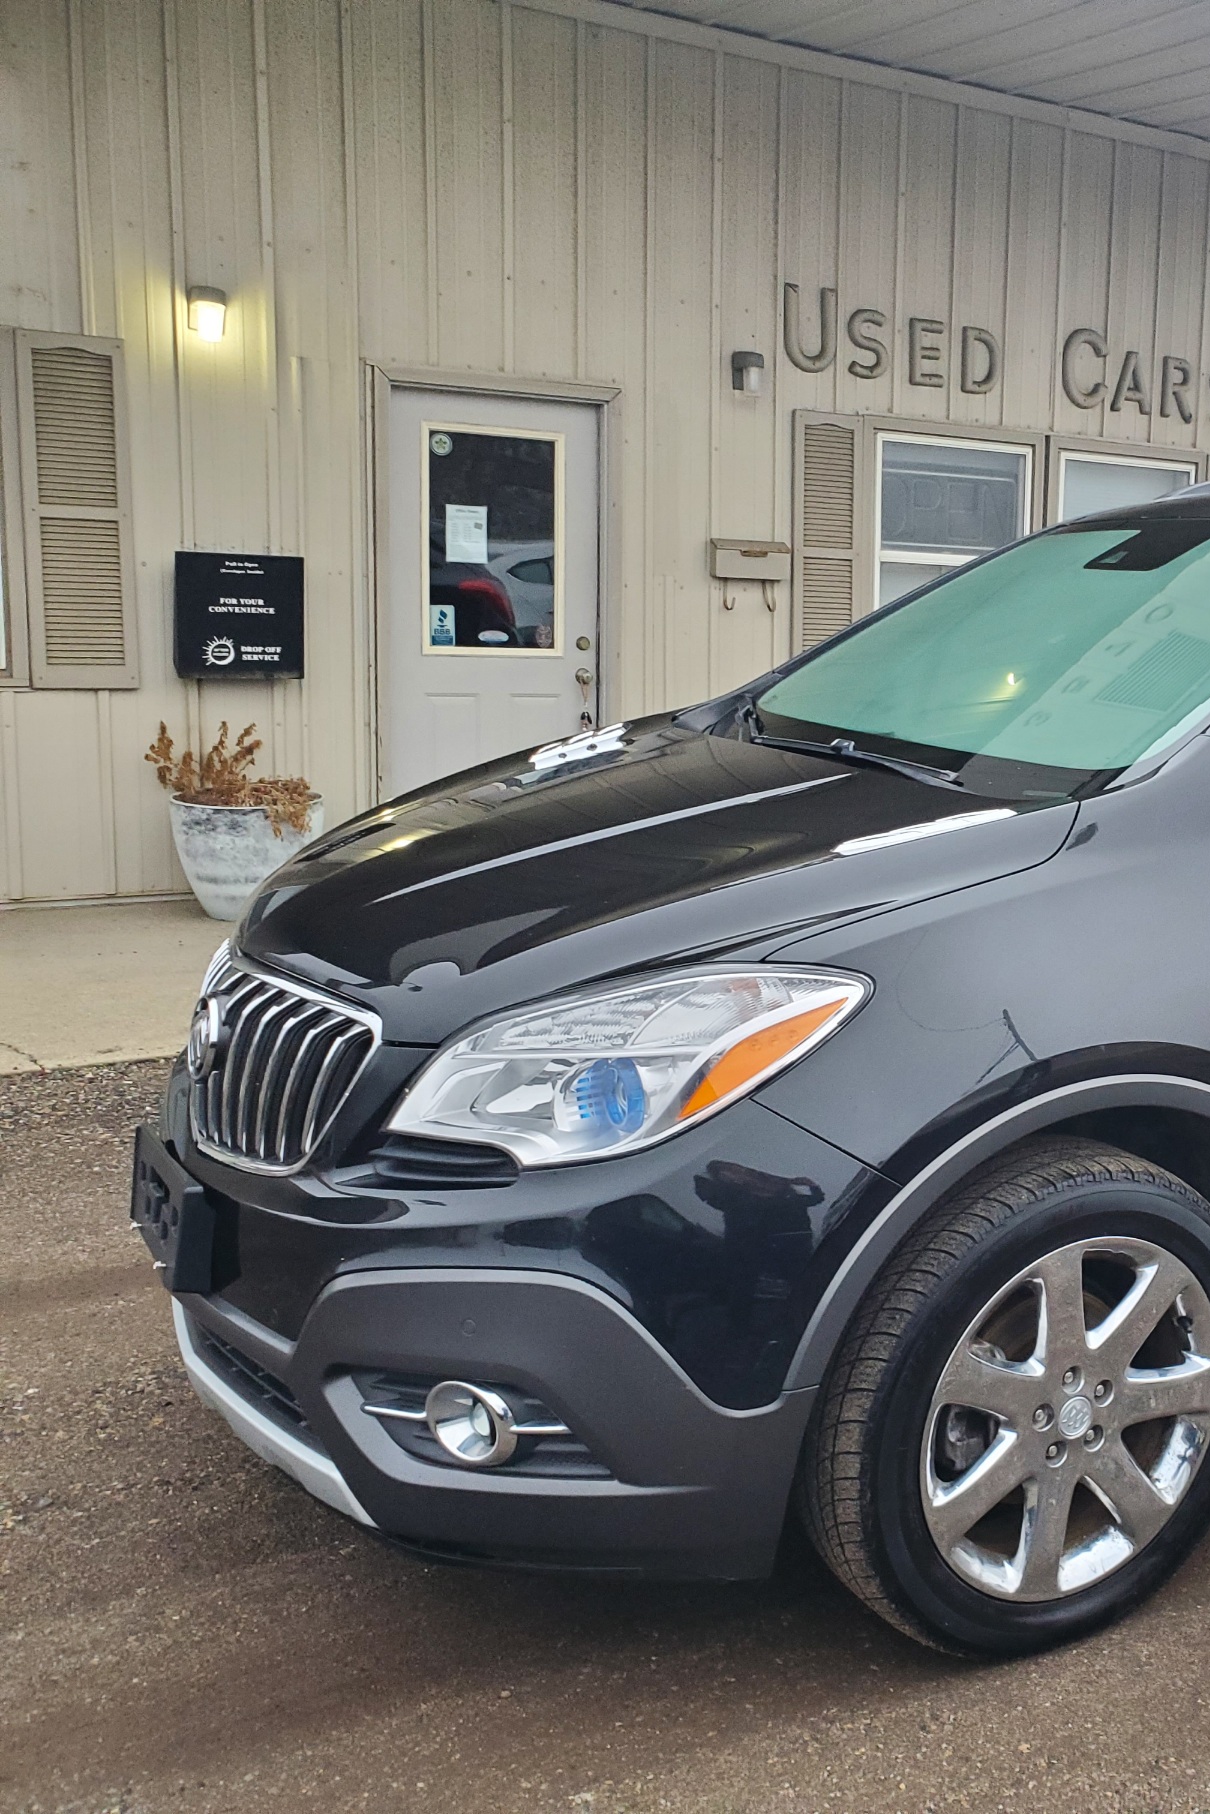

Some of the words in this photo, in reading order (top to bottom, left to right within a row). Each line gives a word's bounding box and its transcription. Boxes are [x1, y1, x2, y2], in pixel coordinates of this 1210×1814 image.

[783, 282, 999, 394] USED
[220, 597, 238, 605] FOR
[239, 598, 265, 606] YOUR
[208, 606, 276, 615] CONVENIENCE
